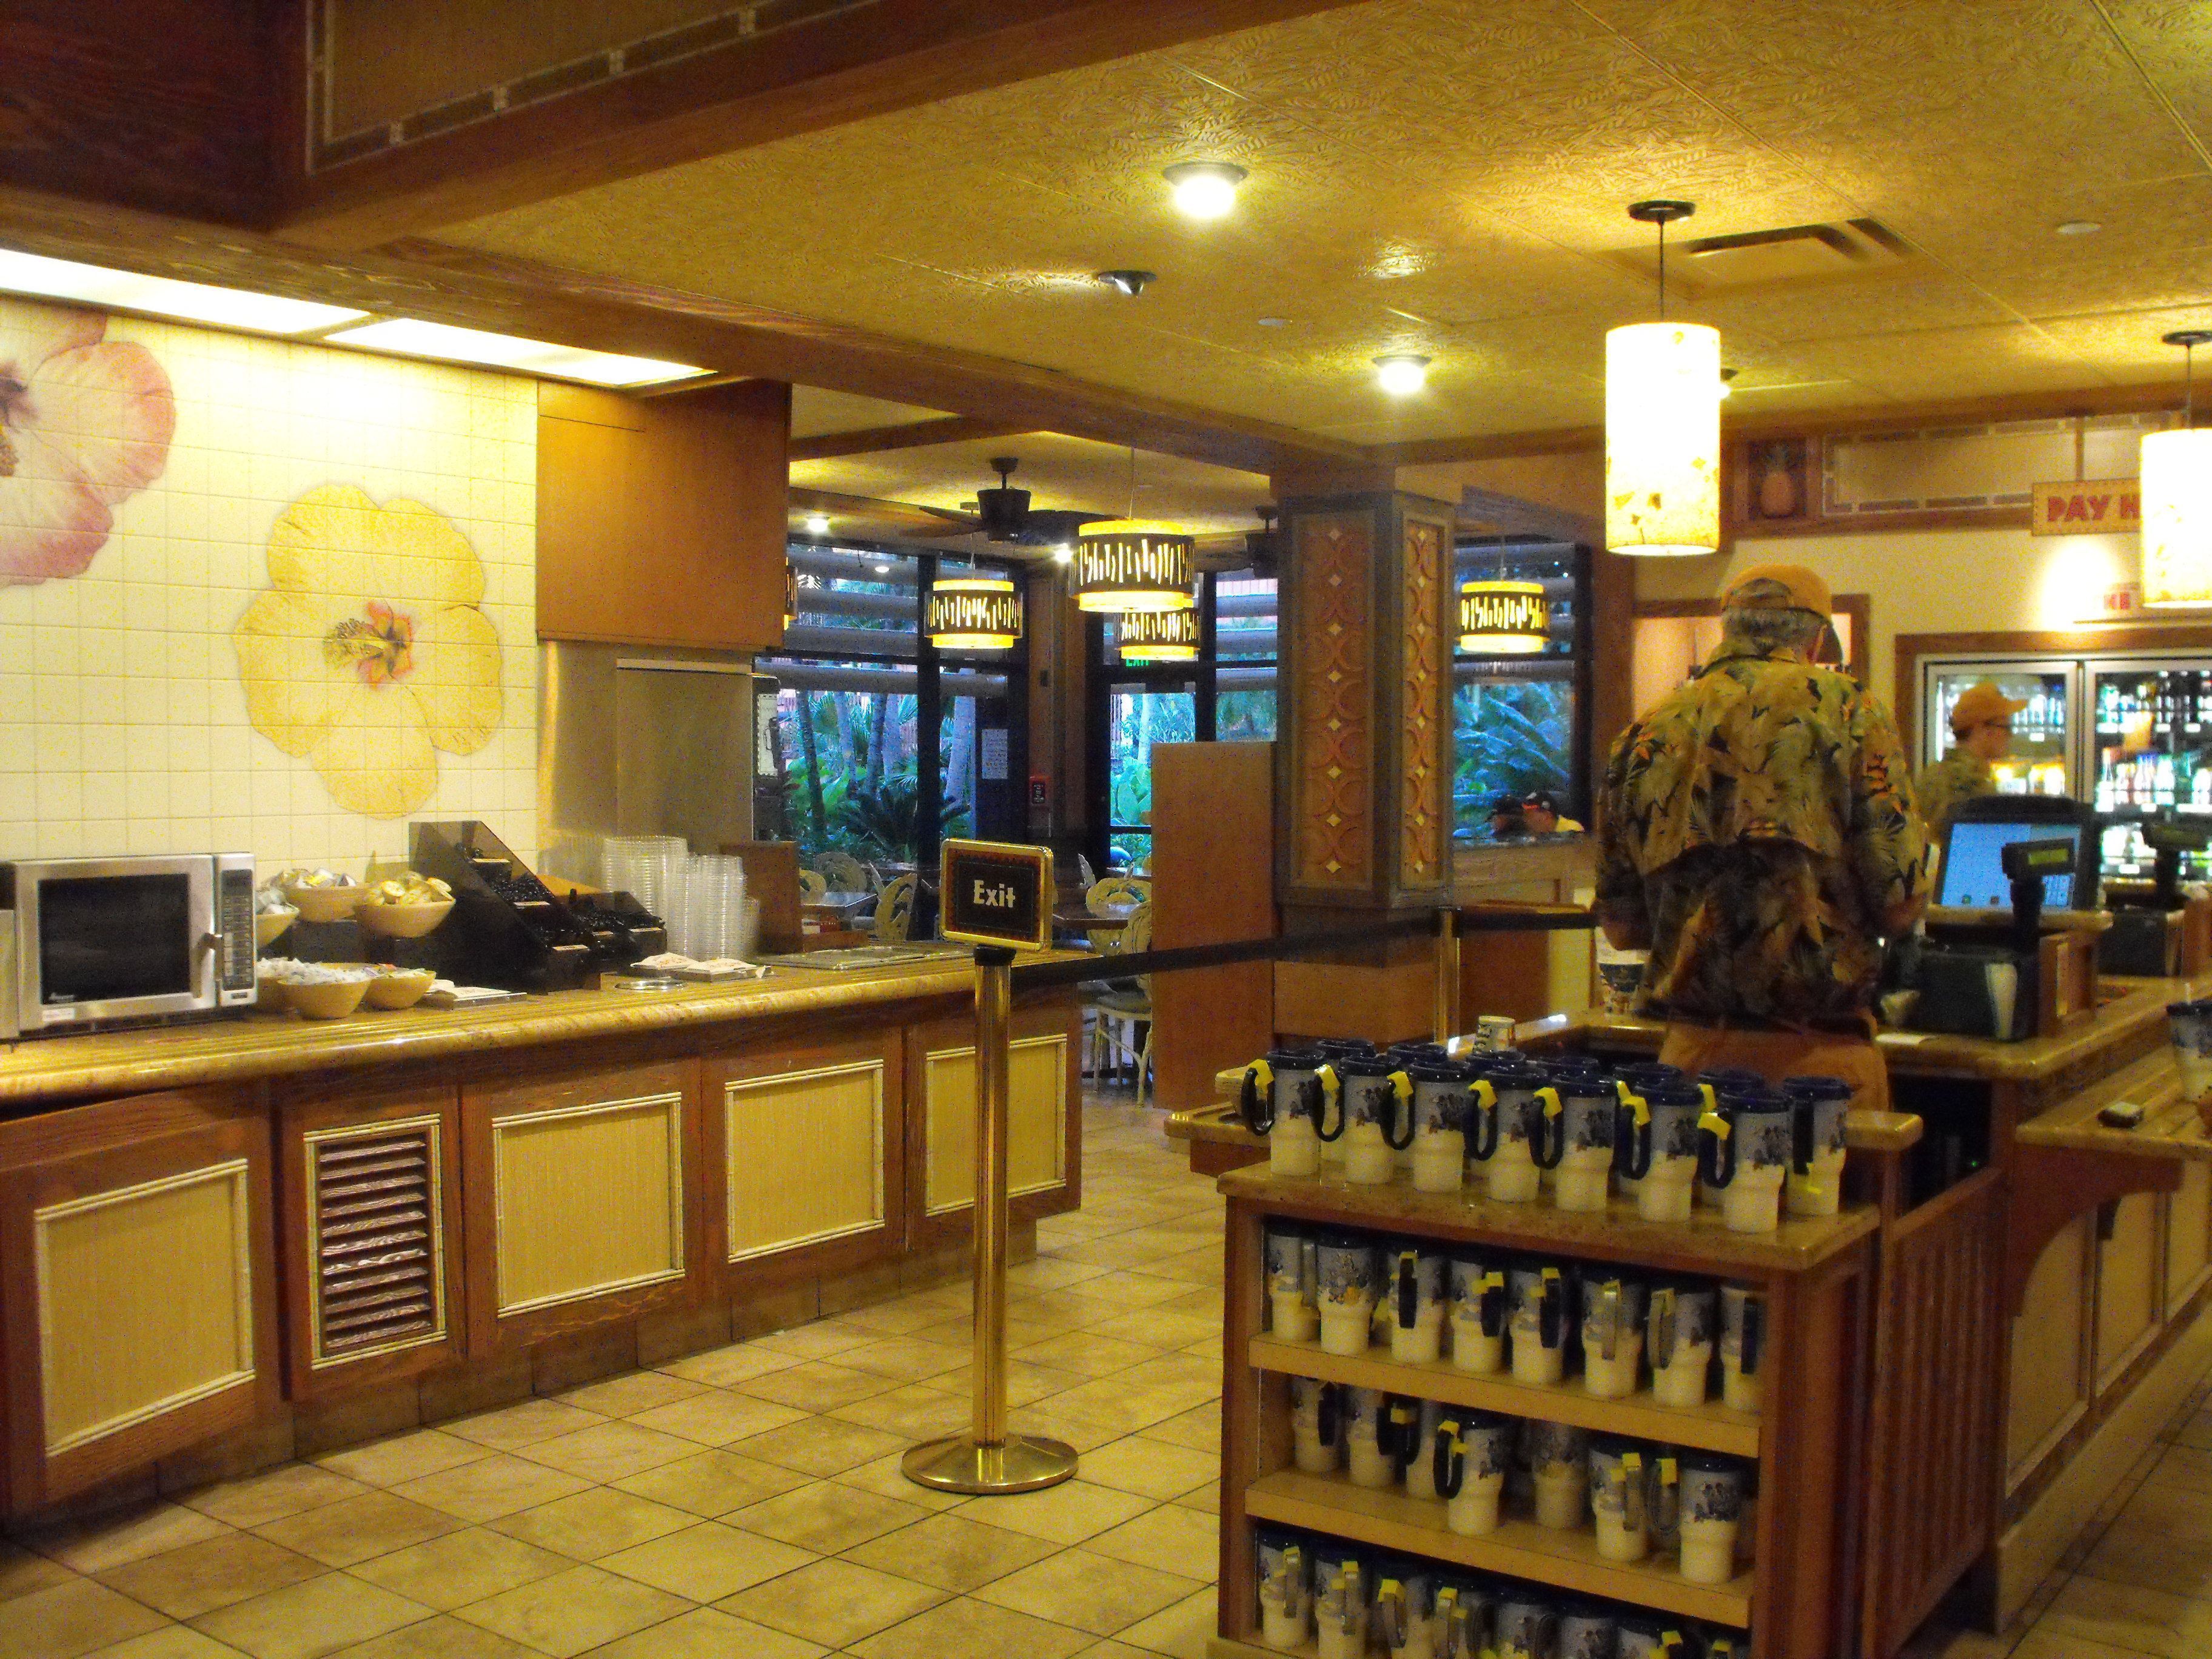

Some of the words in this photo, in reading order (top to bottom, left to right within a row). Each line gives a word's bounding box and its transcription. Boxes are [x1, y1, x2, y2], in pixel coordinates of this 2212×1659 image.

[2047, 494, 2111, 521] PAY
[2121, 494, 2140, 520] H
[974, 880, 1015, 907] Exit
